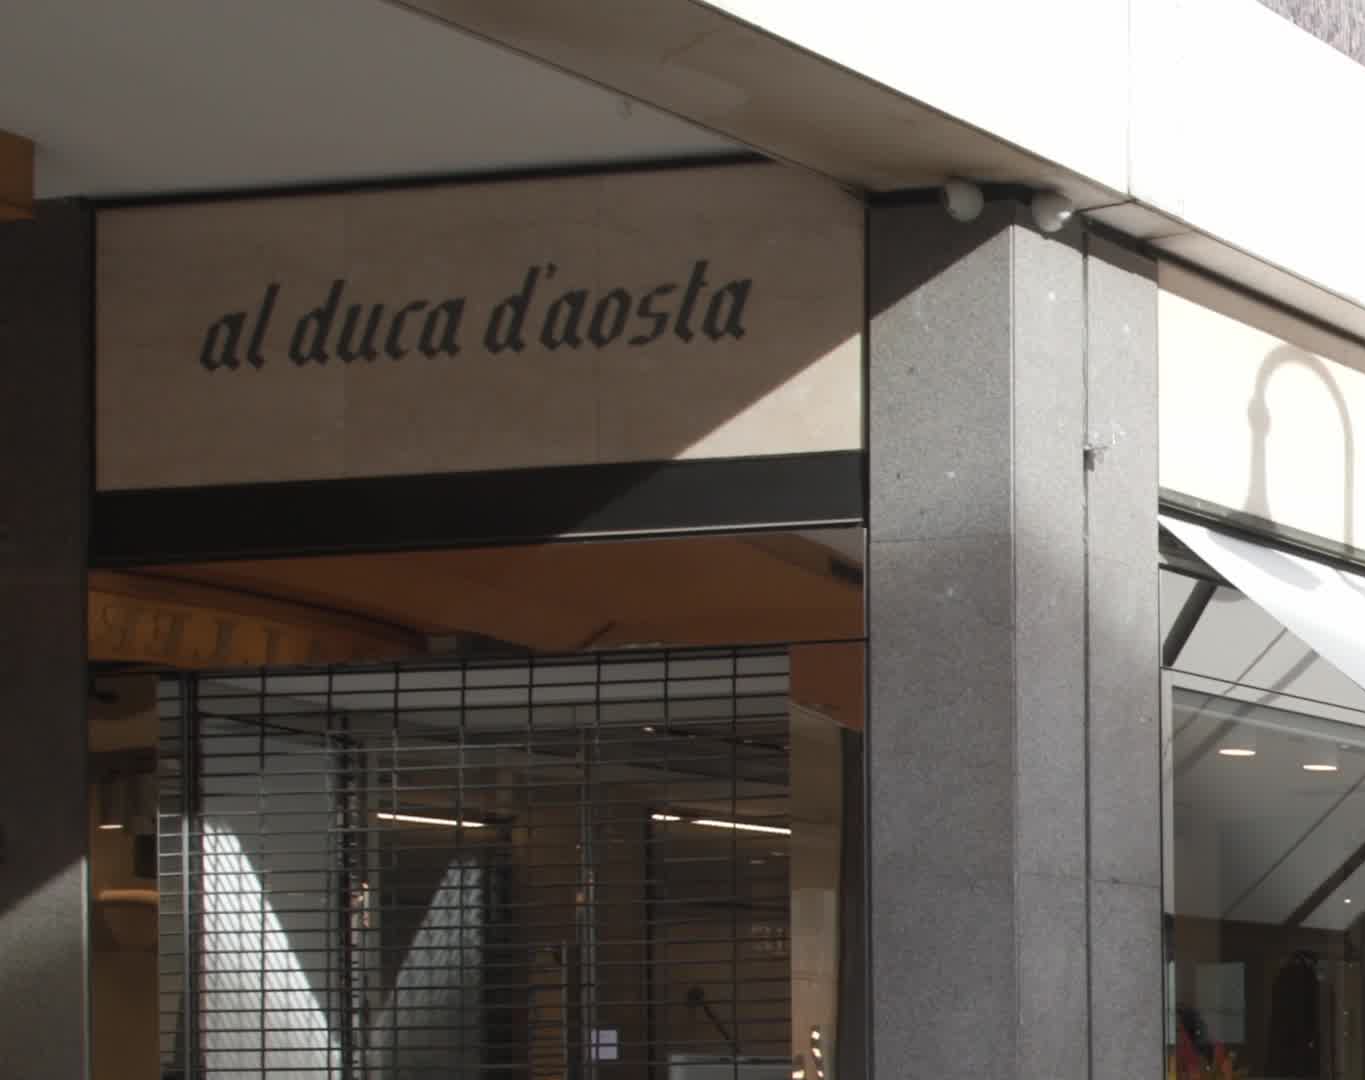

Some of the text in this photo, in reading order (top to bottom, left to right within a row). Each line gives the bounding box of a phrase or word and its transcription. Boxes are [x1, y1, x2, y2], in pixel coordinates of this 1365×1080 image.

[200, 260, 752, 371] al duca d'aosta
